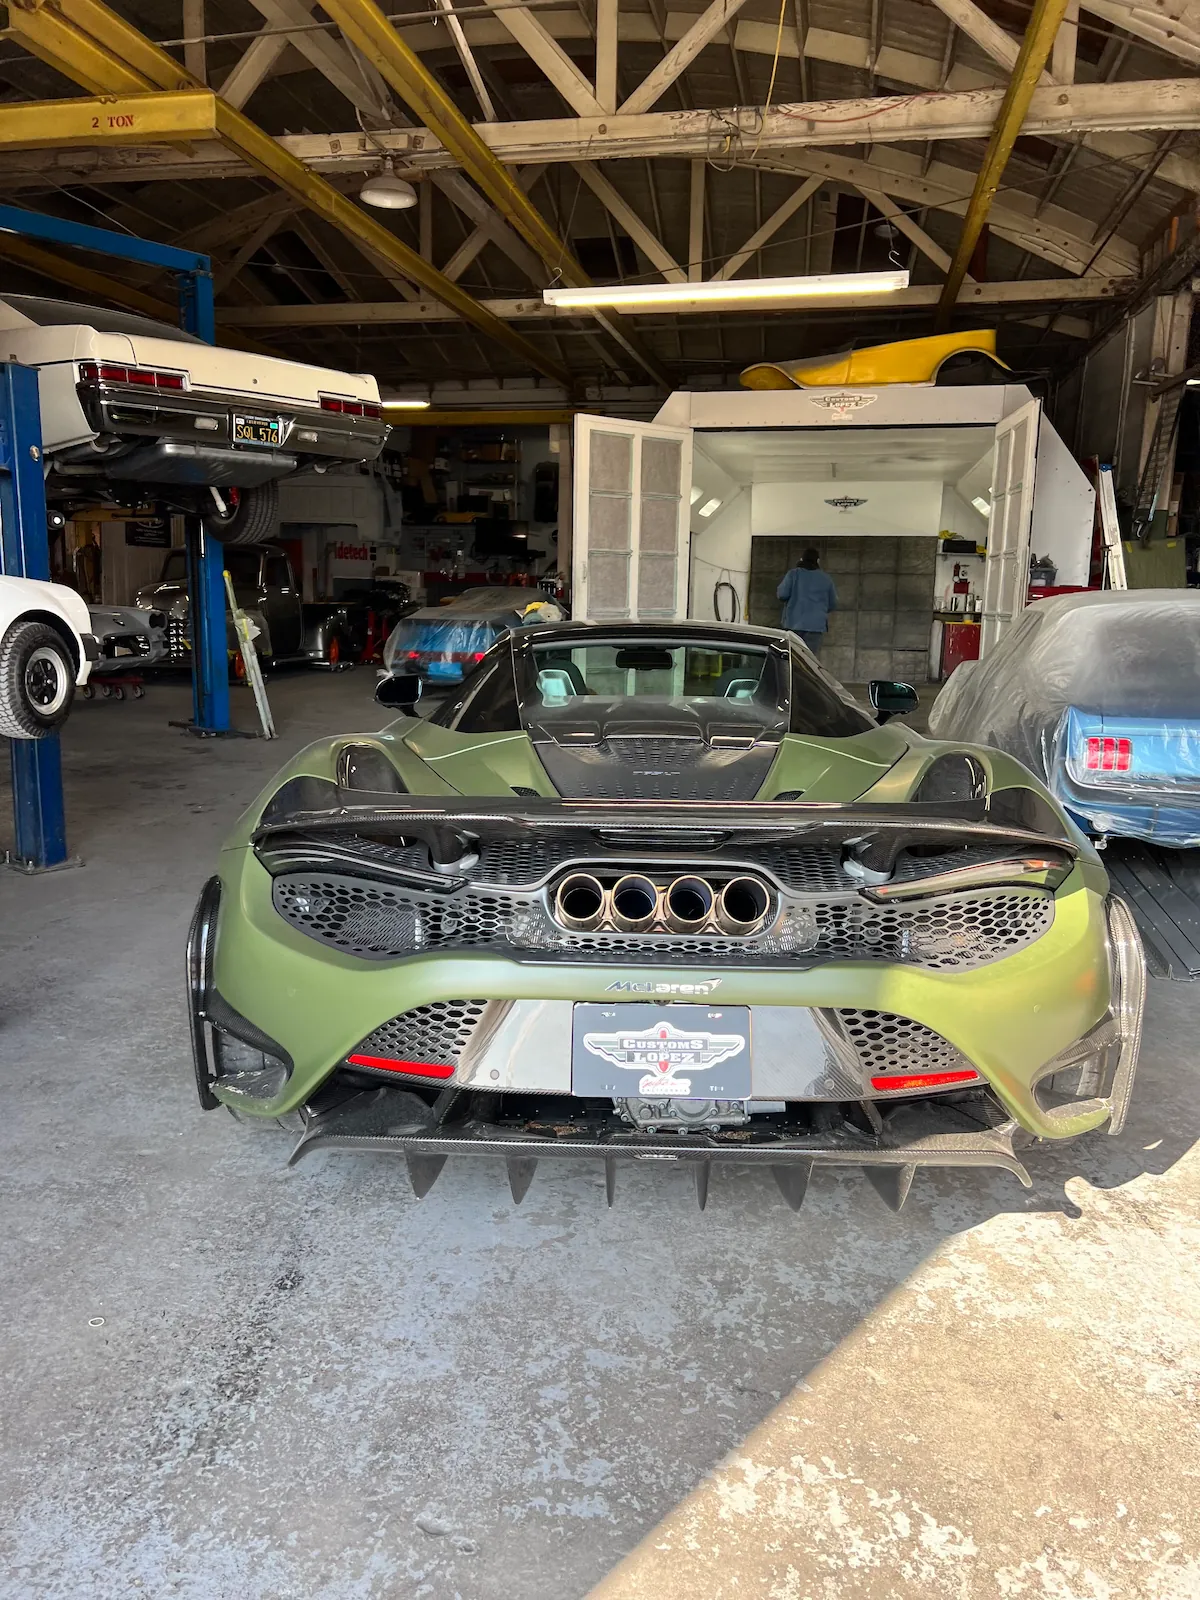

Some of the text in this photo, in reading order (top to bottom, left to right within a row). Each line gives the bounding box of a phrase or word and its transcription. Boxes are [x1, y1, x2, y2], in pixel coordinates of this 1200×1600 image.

[91, 114, 134, 128] 2 TON
[236, 424, 258, 441] SQL
[259, 427, 278, 444] 576
[604, 980, 709, 995] McLaren
[622, 1038, 704, 1050] CUSTOMS
[633, 1051, 695, 1063] LOPEZ
